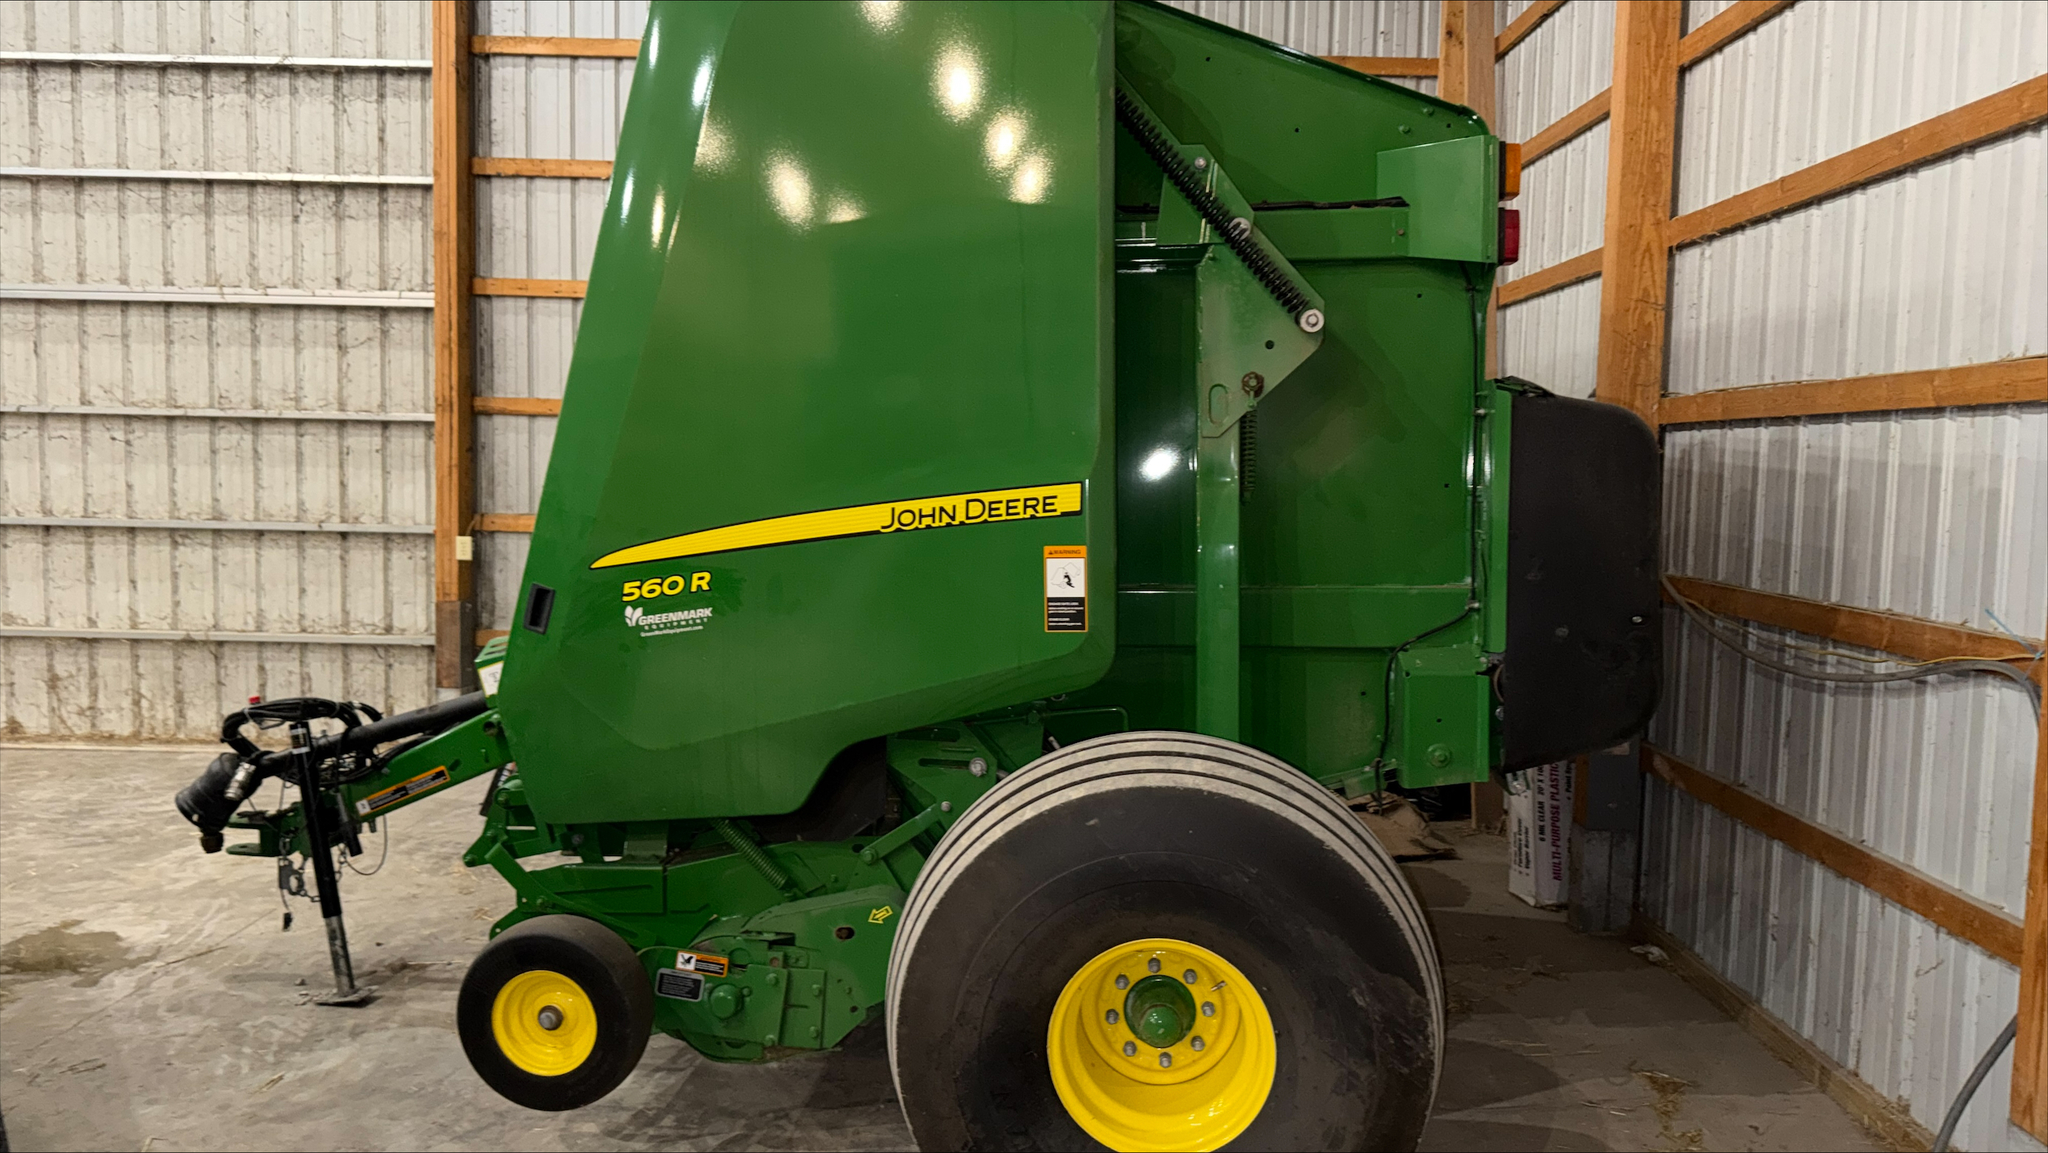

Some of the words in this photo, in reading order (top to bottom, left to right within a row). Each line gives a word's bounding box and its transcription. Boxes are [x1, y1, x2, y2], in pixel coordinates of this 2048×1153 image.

[881, 505, 957, 530] JOHN
[965, 495, 1058, 521] DEERE
[621, 575, 685, 602] 560
[690, 571, 711, 592] R
[638, 607, 713, 626] GREENMARK
[644, 618, 707, 630] EQUIPMENT
[1549, 763, 1560, 802] PLASTIC
[1551, 805, 1562, 881] MULTI-PURPOSE
